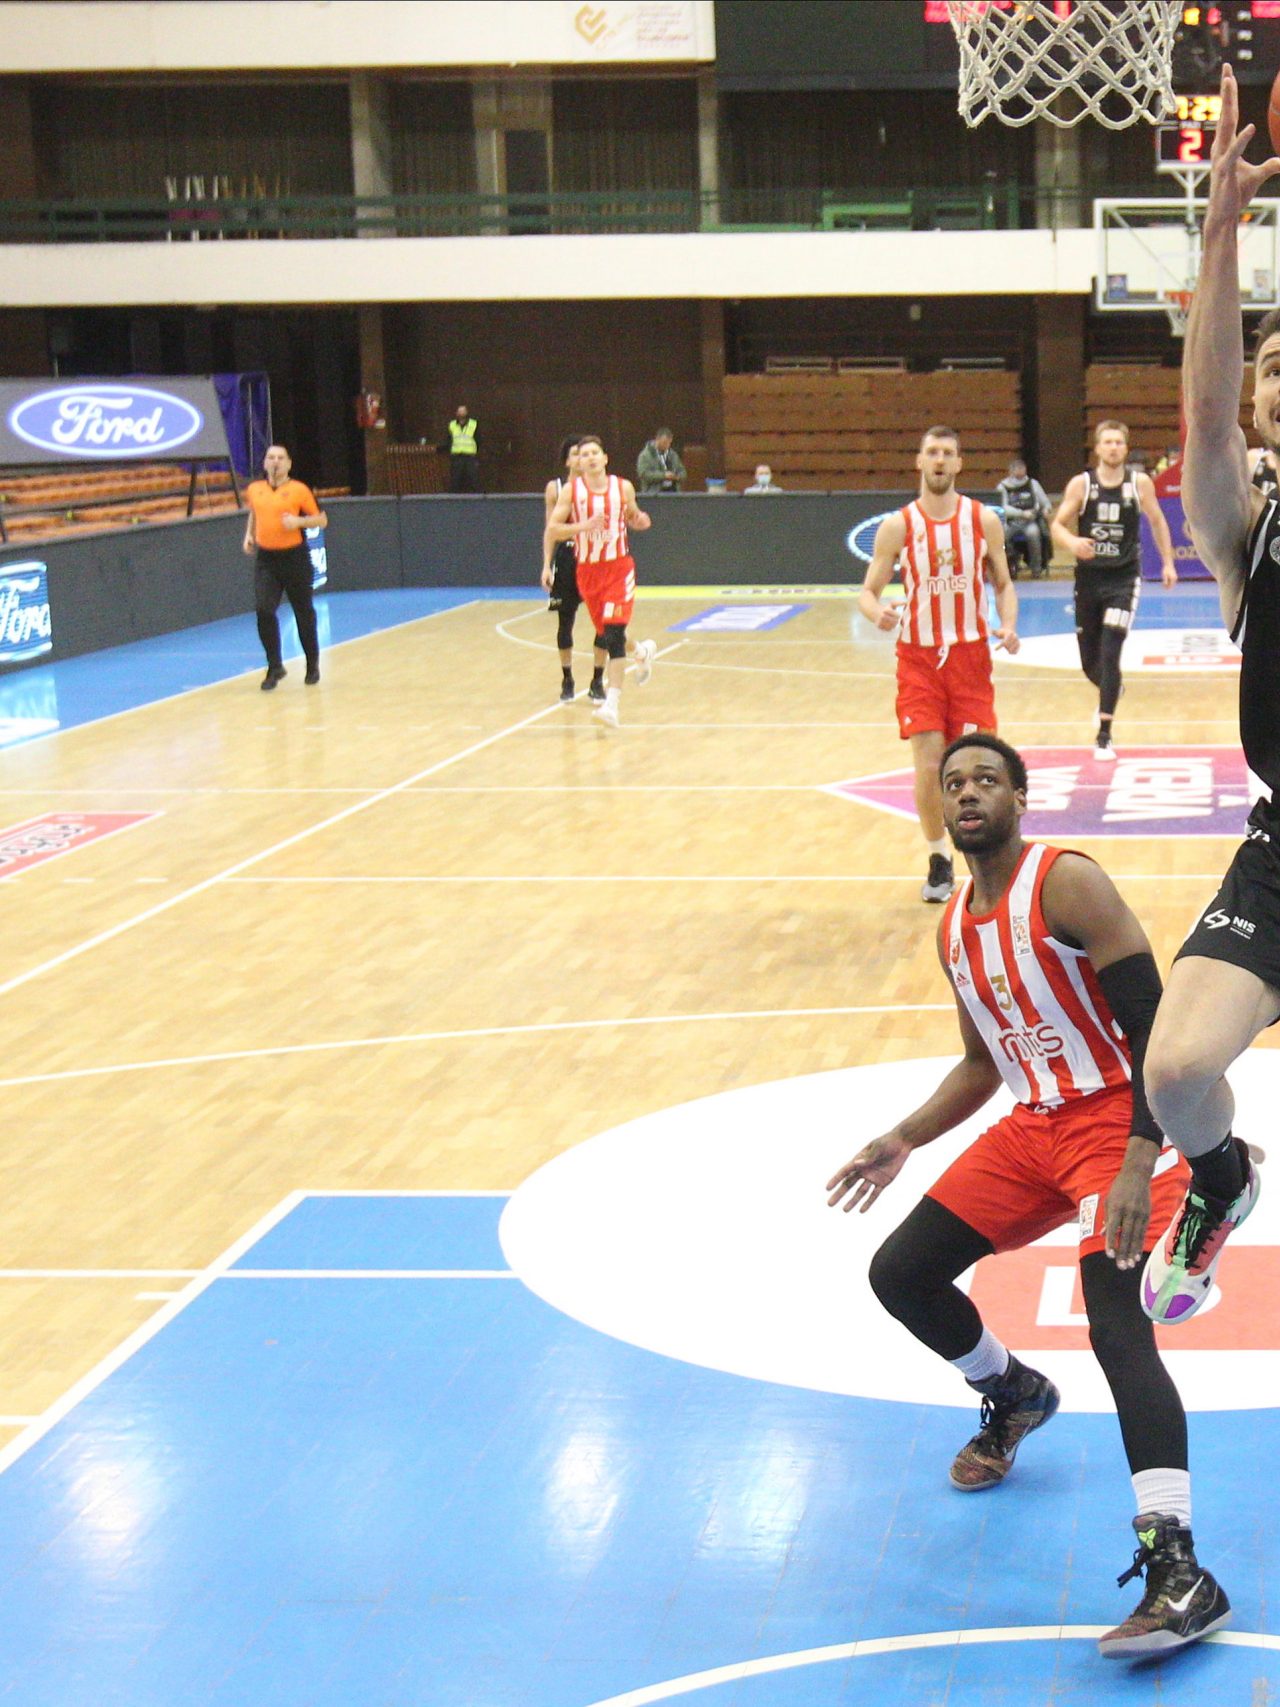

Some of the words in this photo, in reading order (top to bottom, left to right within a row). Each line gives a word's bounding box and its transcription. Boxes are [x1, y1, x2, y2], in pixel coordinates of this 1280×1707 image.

[1179, 129, 1203, 162] 2
[52, 396, 164, 444] Ford
[926, 575, 967, 593] mts
[1232, 915, 1257, 934] NIS
[989, 974, 1013, 1011] 3
[998, 1025, 1064, 1062] mts
